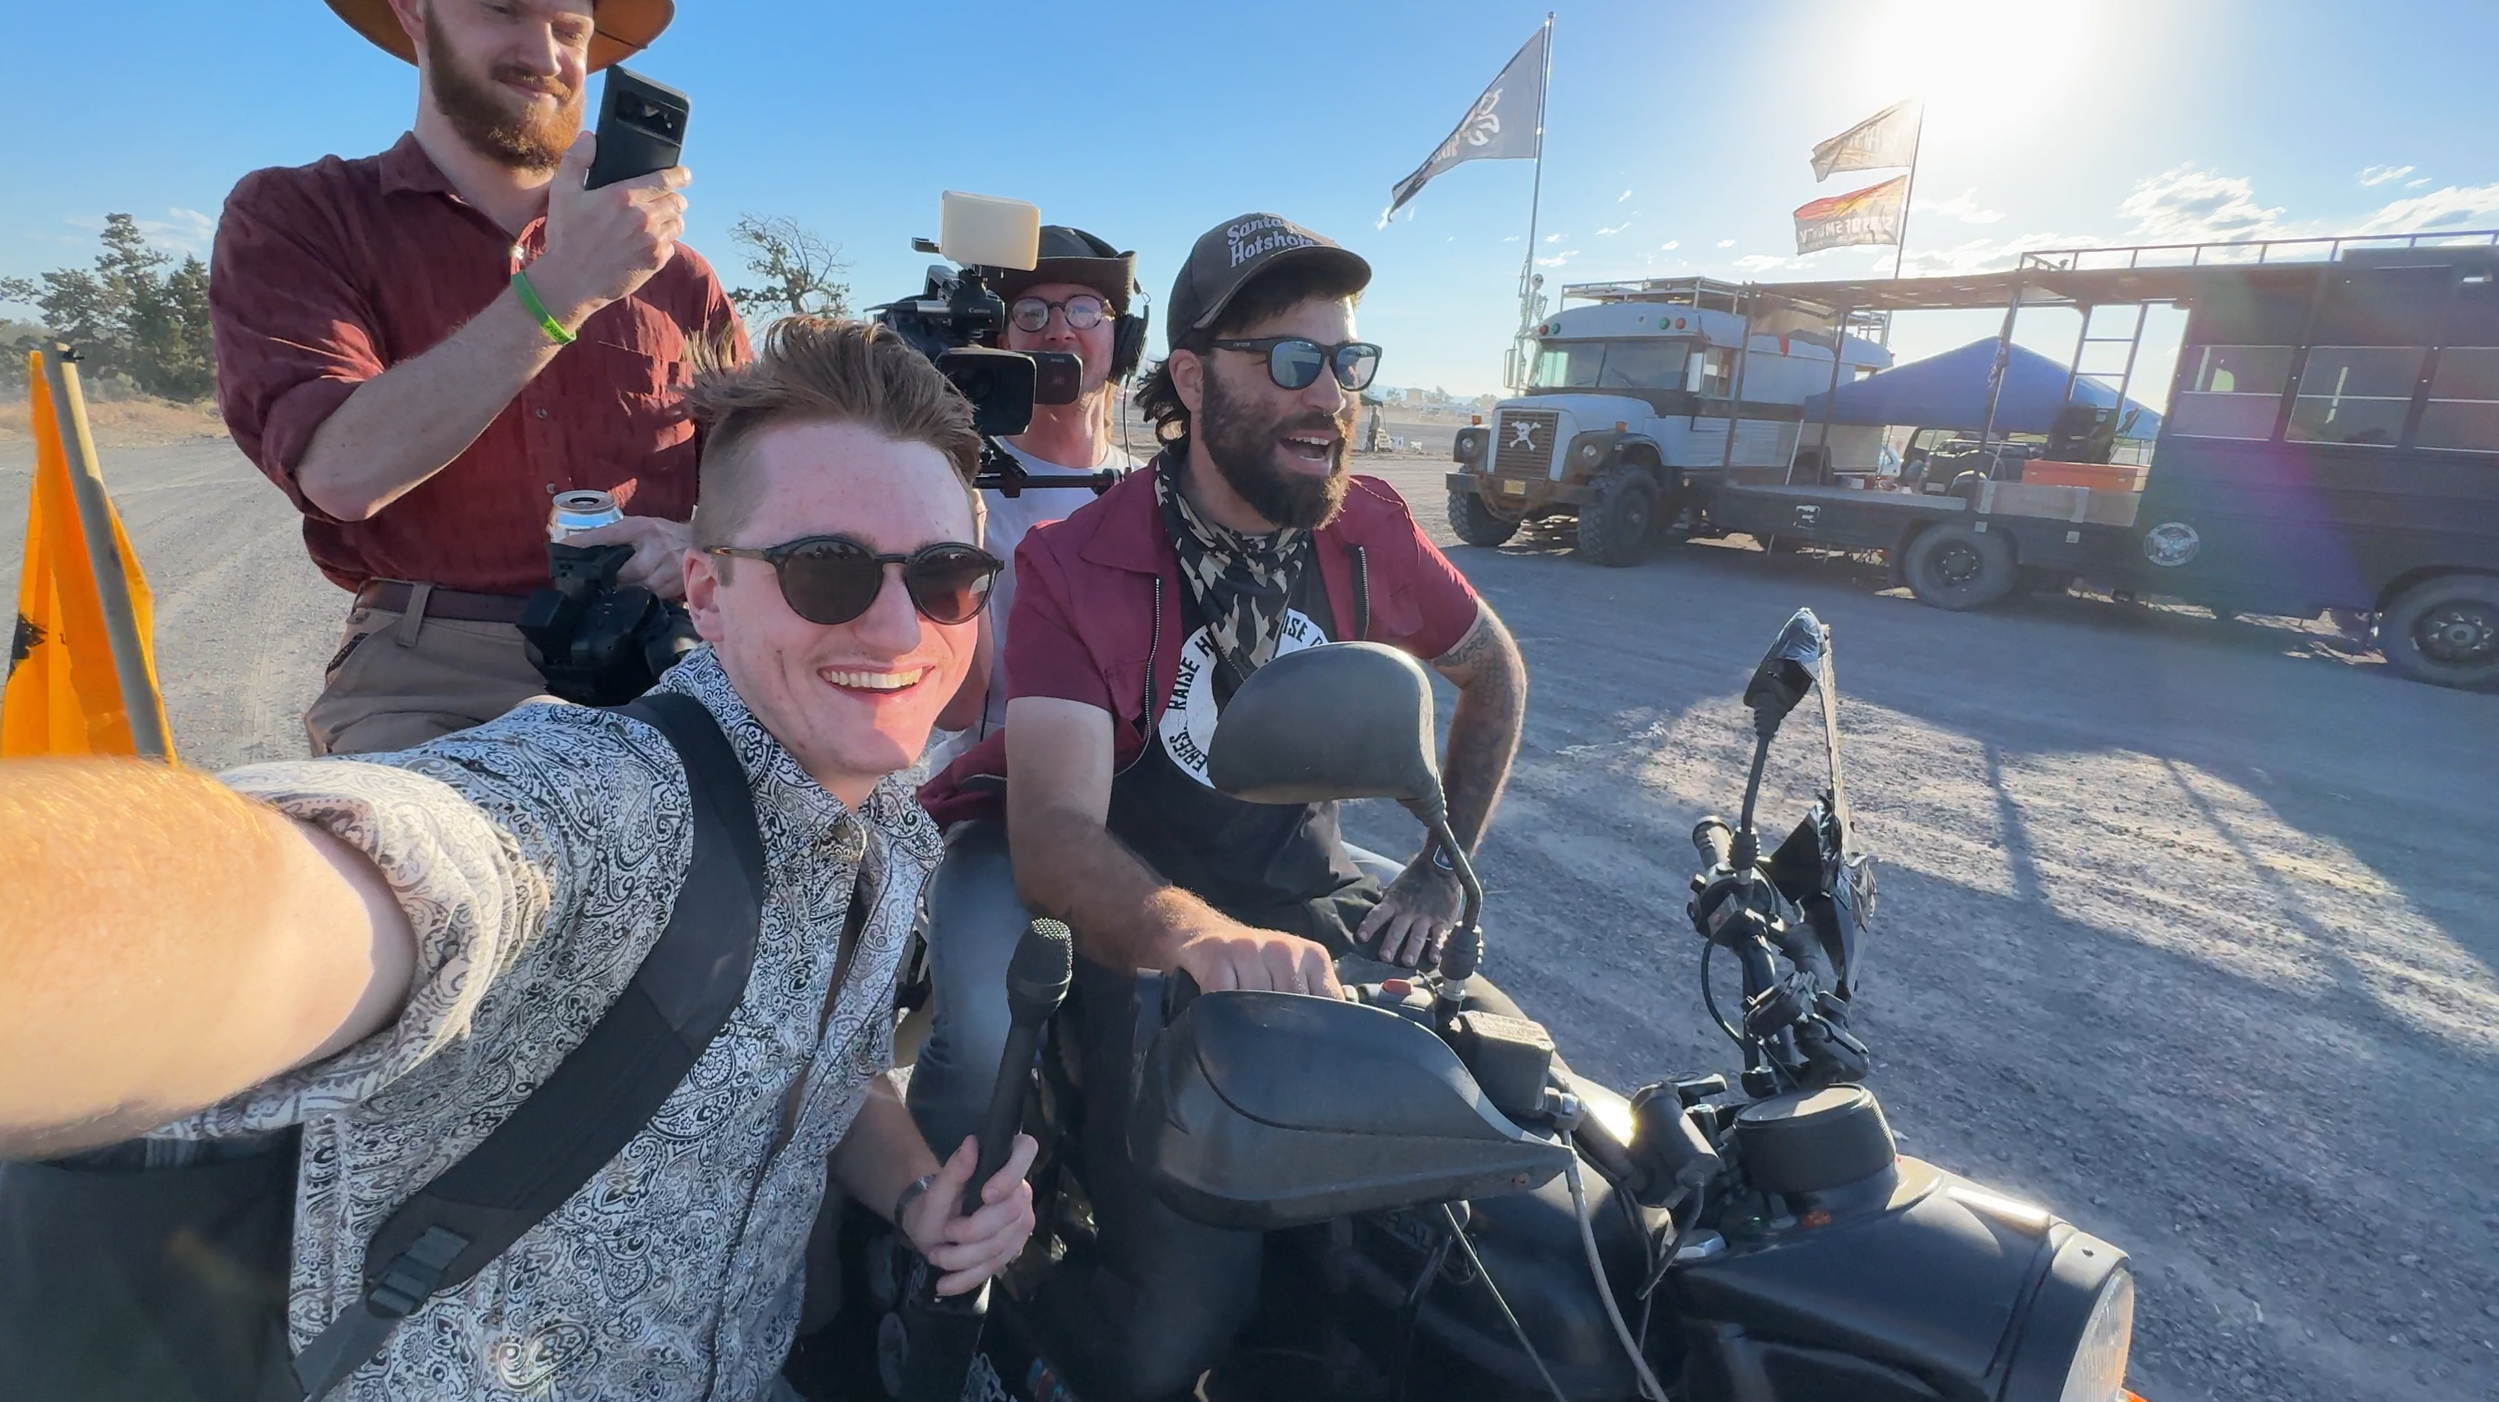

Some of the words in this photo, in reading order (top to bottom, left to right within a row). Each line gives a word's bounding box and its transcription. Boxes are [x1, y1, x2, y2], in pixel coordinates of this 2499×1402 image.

[1227, 216, 1283, 245] Santa
[1230, 230, 1314, 268] Hotshots
[1282, 615, 1309, 643] ISE
[1168, 656, 1201, 710] RAISE
